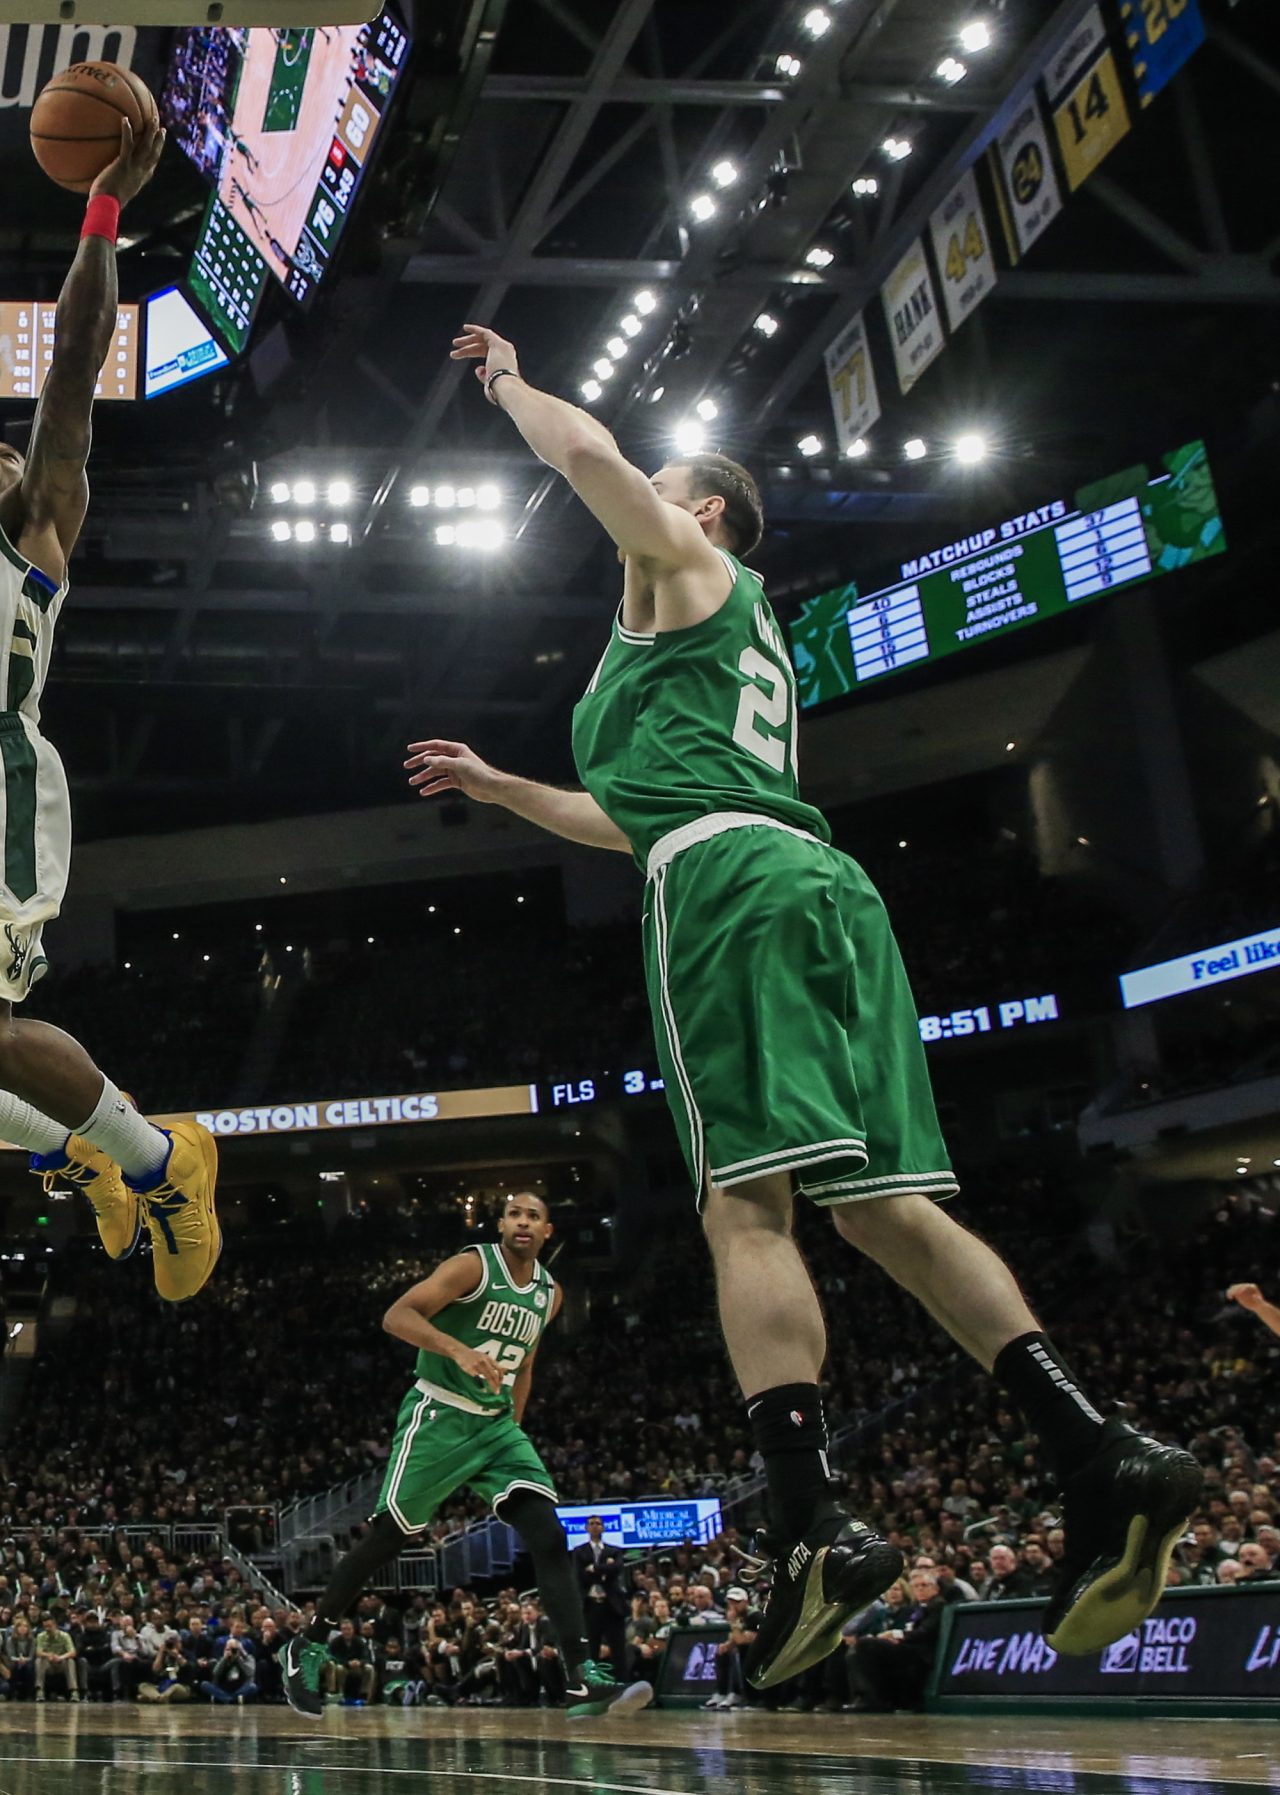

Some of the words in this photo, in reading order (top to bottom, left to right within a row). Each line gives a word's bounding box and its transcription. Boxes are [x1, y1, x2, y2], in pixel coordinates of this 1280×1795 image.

[1067, 72, 1110, 145] 14
[945, 211, 984, 283] 44
[893, 279, 932, 346] HANK
[901, 528, 996, 579] MATCHUP
[1000, 500, 1066, 539] STATS
[950, 544, 1024, 582] REBOUNDS
[962, 563, 1016, 593] BLOCKS
[966, 579, 1018, 608] STEALS
[966, 593, 1024, 623] ASSISTS
[955, 602, 1038, 641] TURNOVERS
[1192, 950, 1239, 979] Feel
[919, 1007, 991, 1042] 8:51
[999, 994, 1059, 1027] PM
[552, 1080, 595, 1106] FLS
[624, 1070, 645, 1094] 3
[196, 1104, 318, 1134] BOSTON
[325, 1095, 439, 1126] CELTICS
[476, 1301, 542, 1346] BOSTON
[787, 1541, 812, 1582] ANTA
[1143, 1616, 1197, 1645] TACO
[1138, 1646, 1190, 1673] BELL
